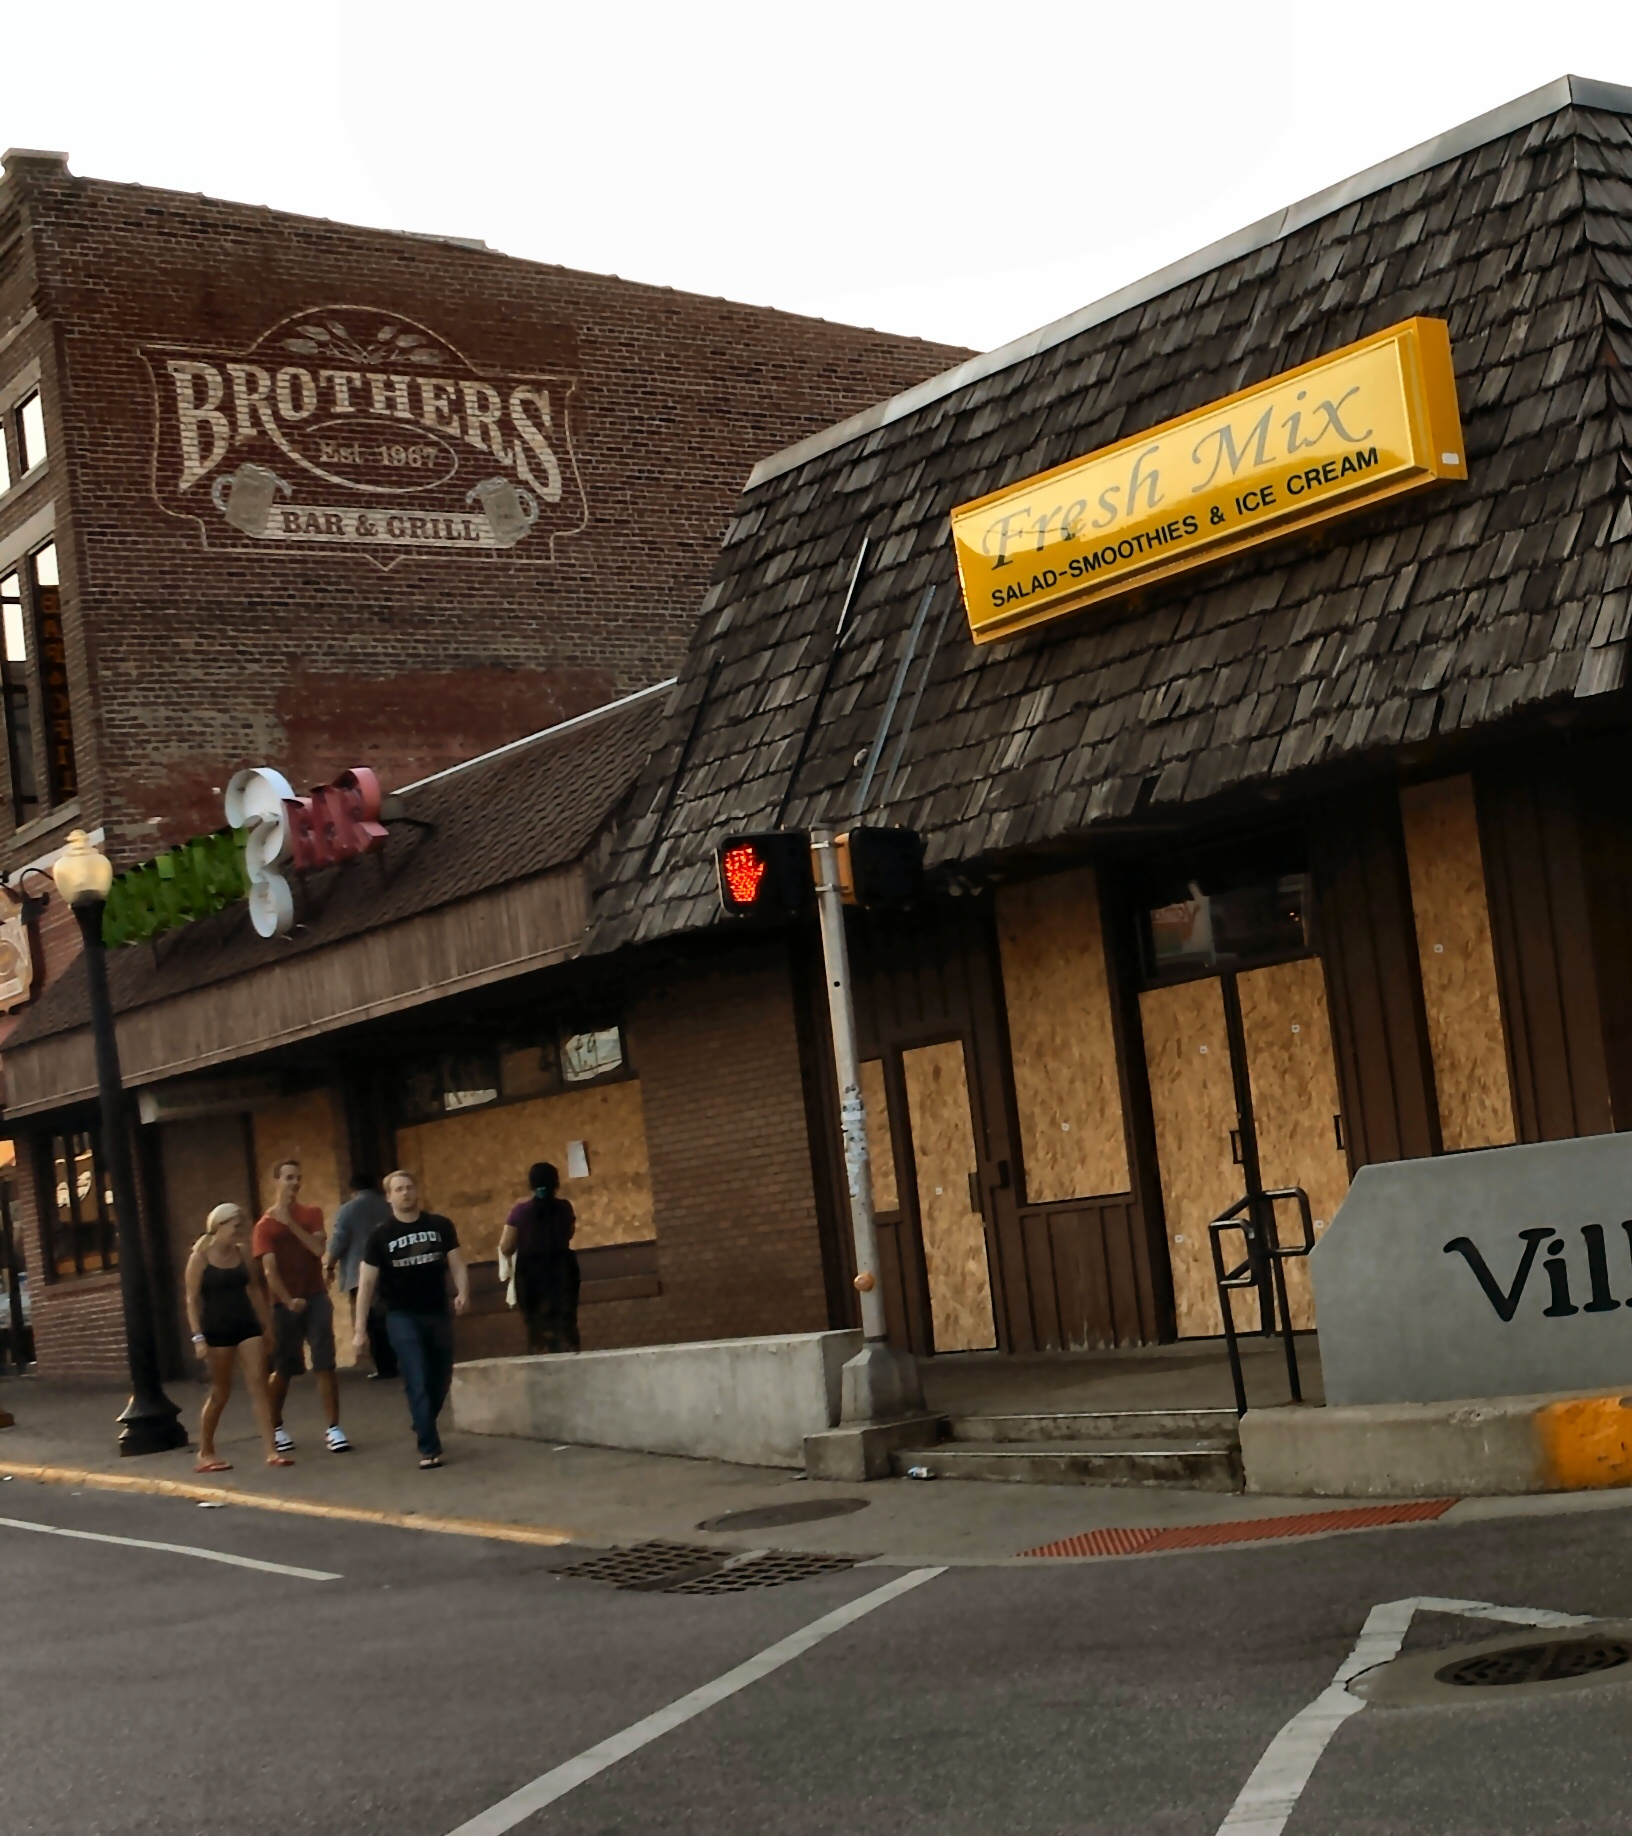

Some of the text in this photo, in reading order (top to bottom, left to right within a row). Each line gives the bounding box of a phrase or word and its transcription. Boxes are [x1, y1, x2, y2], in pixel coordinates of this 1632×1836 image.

[167, 360, 562, 502] BROTHERS
[380, 444, 440, 469] 1967
[981, 386, 1373, 571] Fresh Mix
[282, 511, 481, 542] BAR & GRILL
[991, 446, 1379, 608] SALAD-SMOOTHIES & ICE CREAM
